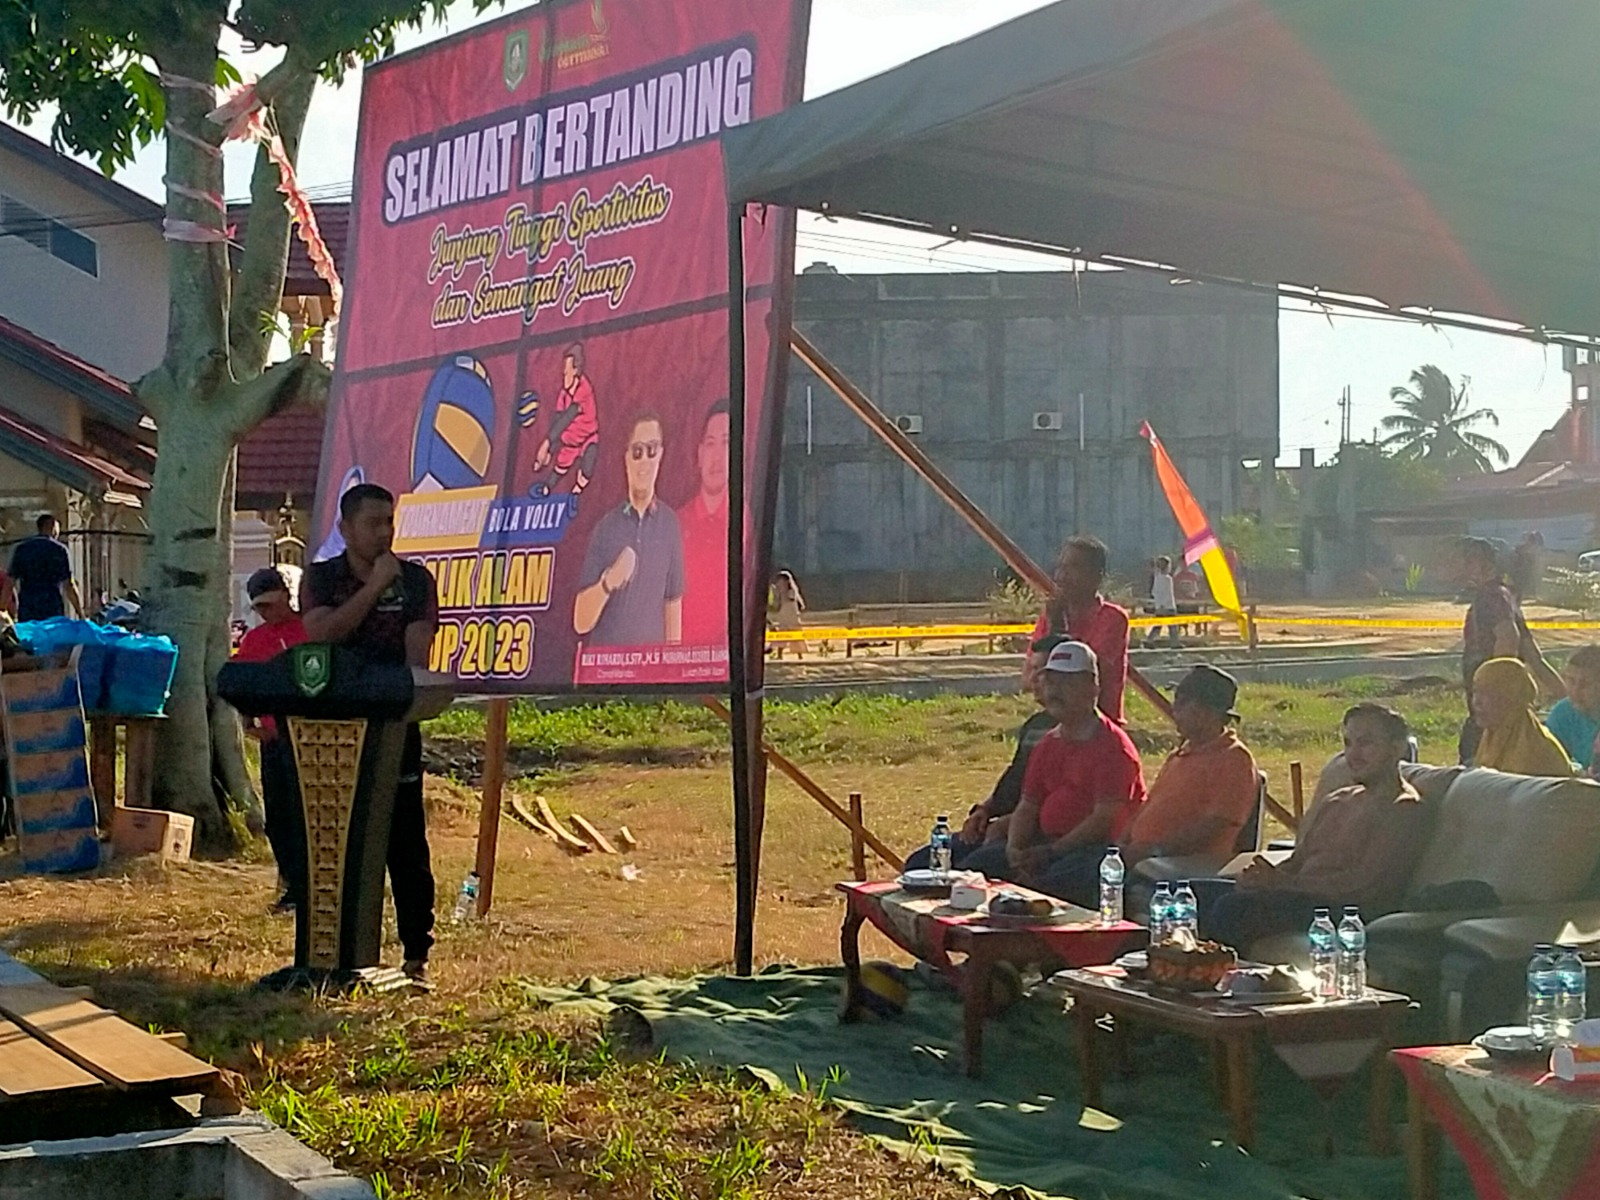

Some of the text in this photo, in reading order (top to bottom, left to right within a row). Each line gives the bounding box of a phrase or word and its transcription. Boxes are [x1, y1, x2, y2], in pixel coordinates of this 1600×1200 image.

[384, 48, 753, 222] SELAMAT BERTANDING
[431, 178, 670, 277] Junjung Tinggi Sportivitas
[434, 255, 633, 325] dan Semangat Juang
[488, 506, 521, 533] BOLA
[523, 502, 566, 529] VOLLY
[475, 553, 552, 607] ALAM
[460, 621, 532, 673] 2023
